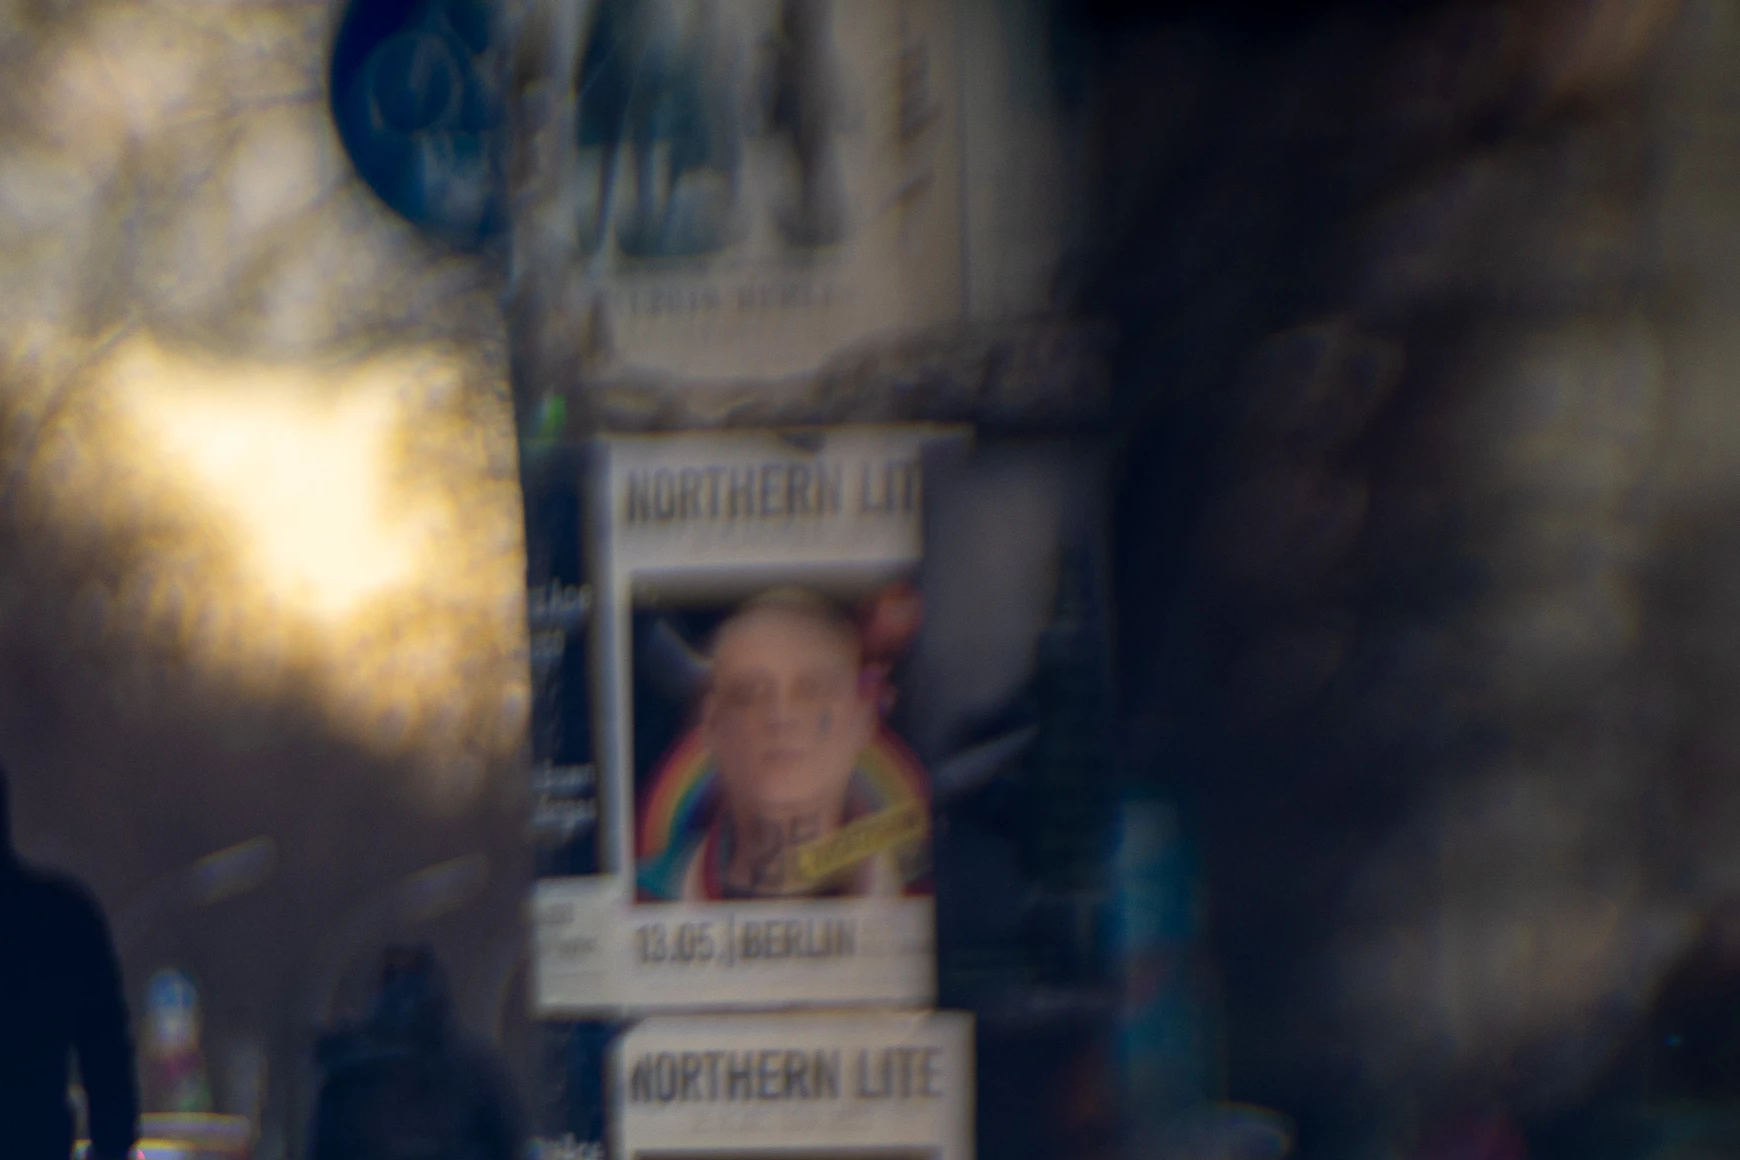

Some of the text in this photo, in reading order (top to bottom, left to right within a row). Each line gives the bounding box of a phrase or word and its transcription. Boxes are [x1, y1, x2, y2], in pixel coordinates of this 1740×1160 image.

[627, 464, 842, 524] NORTHERN
[742, 918, 857, 955] BERLIN
[630, 1046, 944, 1103] NORTHERN LITE
